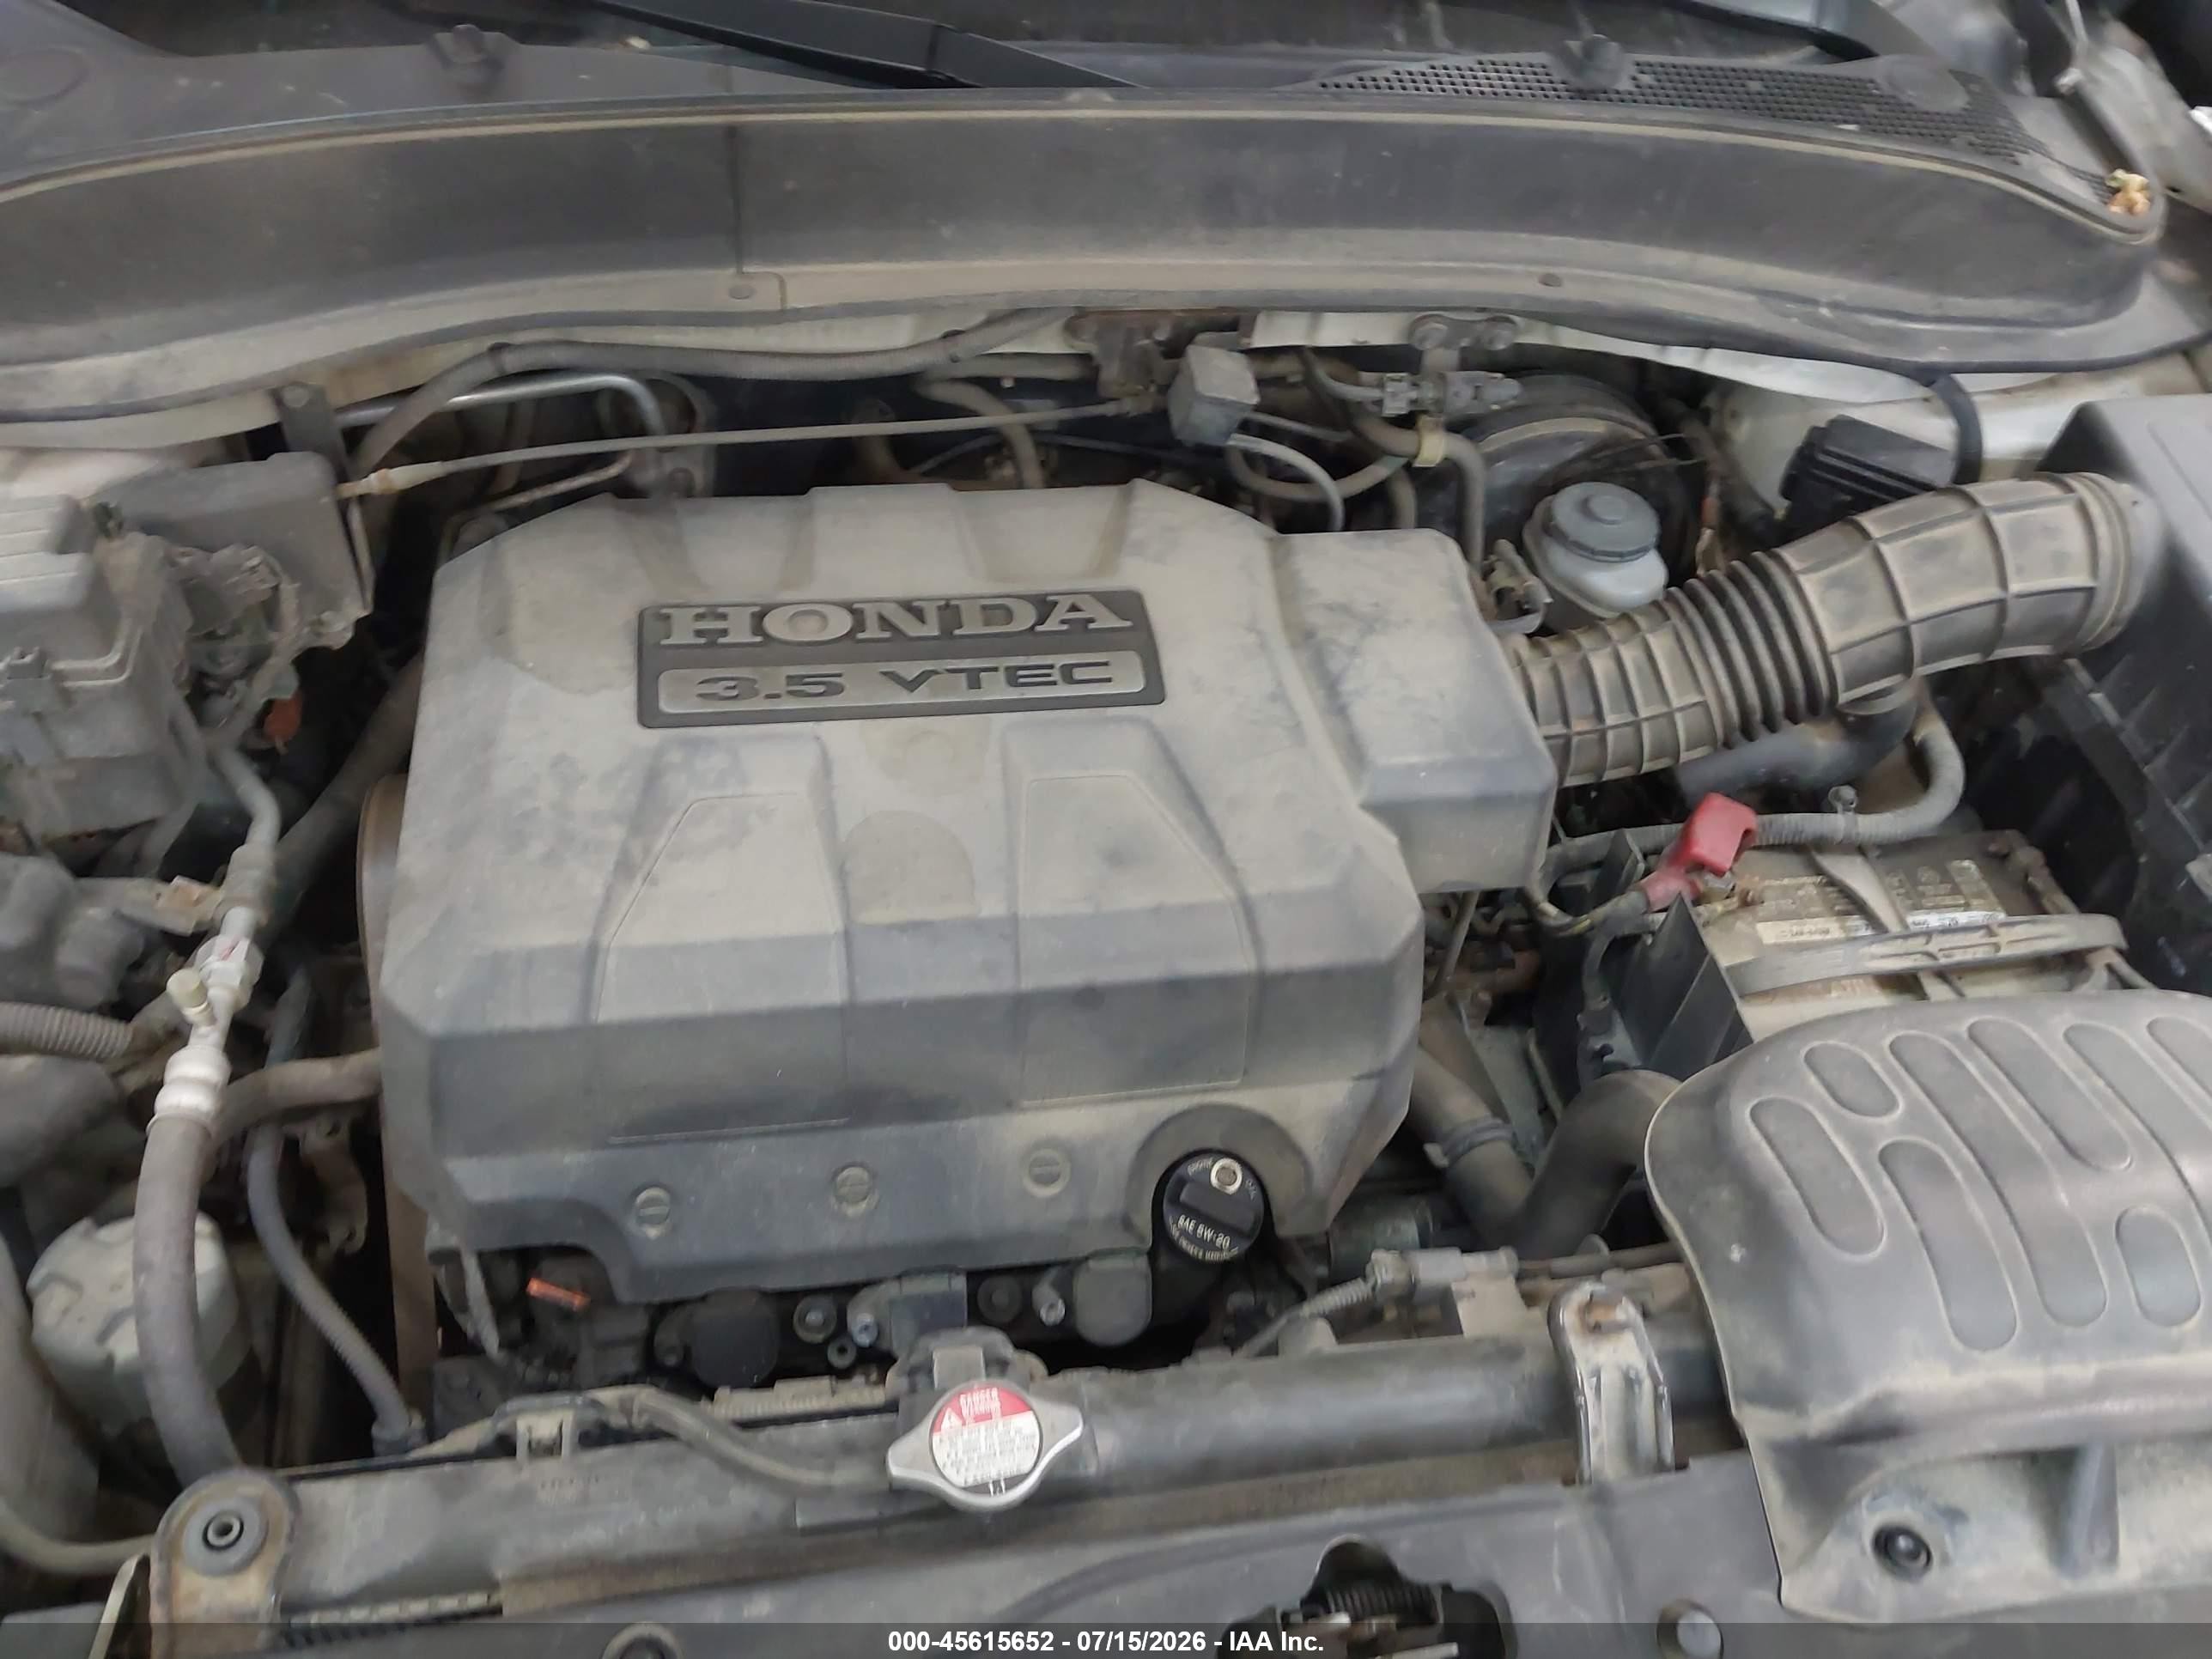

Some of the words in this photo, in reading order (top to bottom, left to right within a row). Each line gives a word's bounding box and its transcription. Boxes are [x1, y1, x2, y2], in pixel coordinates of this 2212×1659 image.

[659, 593, 1133, 646] HONDA
[696, 672, 846, 702] 3.5
[879, 660, 1114, 694] VTEC
